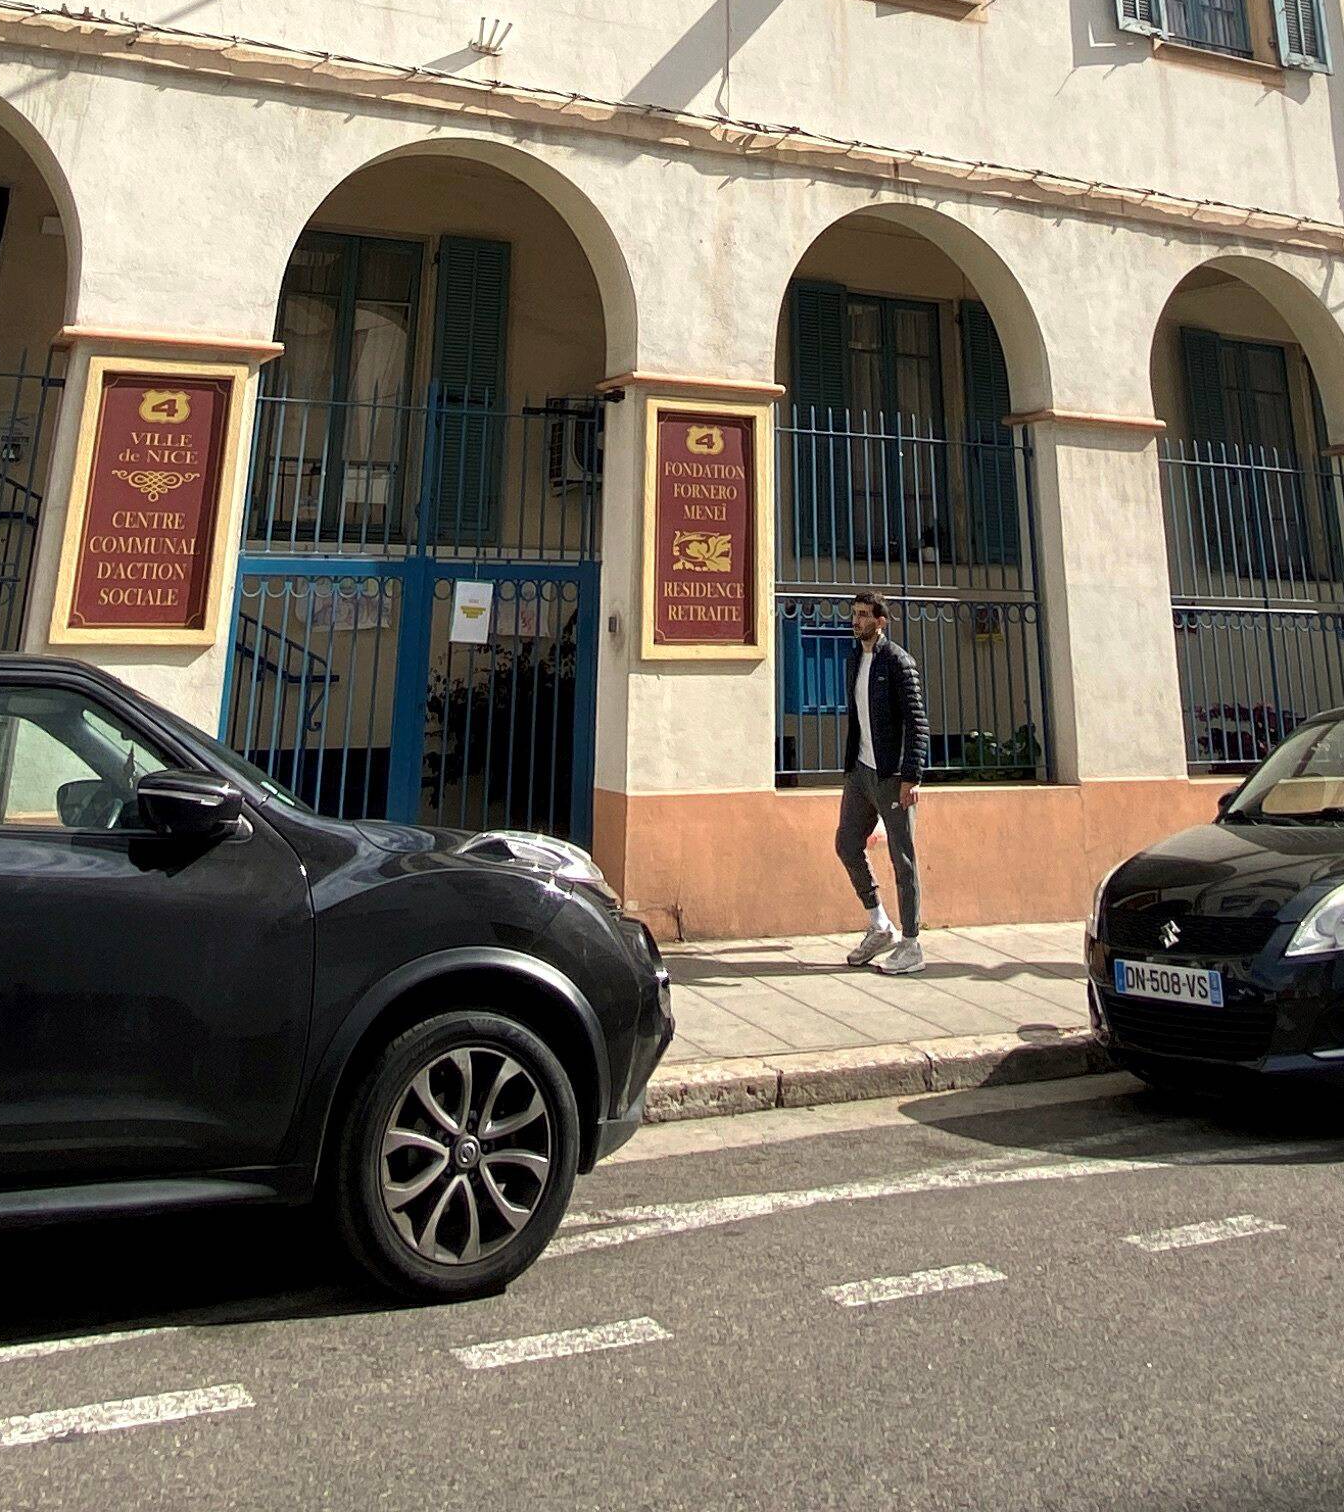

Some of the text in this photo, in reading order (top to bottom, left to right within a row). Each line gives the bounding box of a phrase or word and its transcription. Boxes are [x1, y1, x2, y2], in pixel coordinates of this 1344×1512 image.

[151, 399, 178, 417] 4
[131, 431, 193, 448] VILLE
[696, 434, 715, 449] 4
[118, 449, 198, 465] de NICE
[665, 461, 745, 479] FONDATION
[673, 484, 737, 500] FORNERO
[112, 510, 186, 530] CENTRE
[89, 536, 200, 555] COMMUNAL
[96, 561, 187, 580] D'ACTION
[98, 588, 178, 606] SOCIALE
[664, 582, 745, 598] RESIDENCE
[668, 605, 742, 621] RETRAITE
[1125, 966, 1208, 999] DN-508-VS
